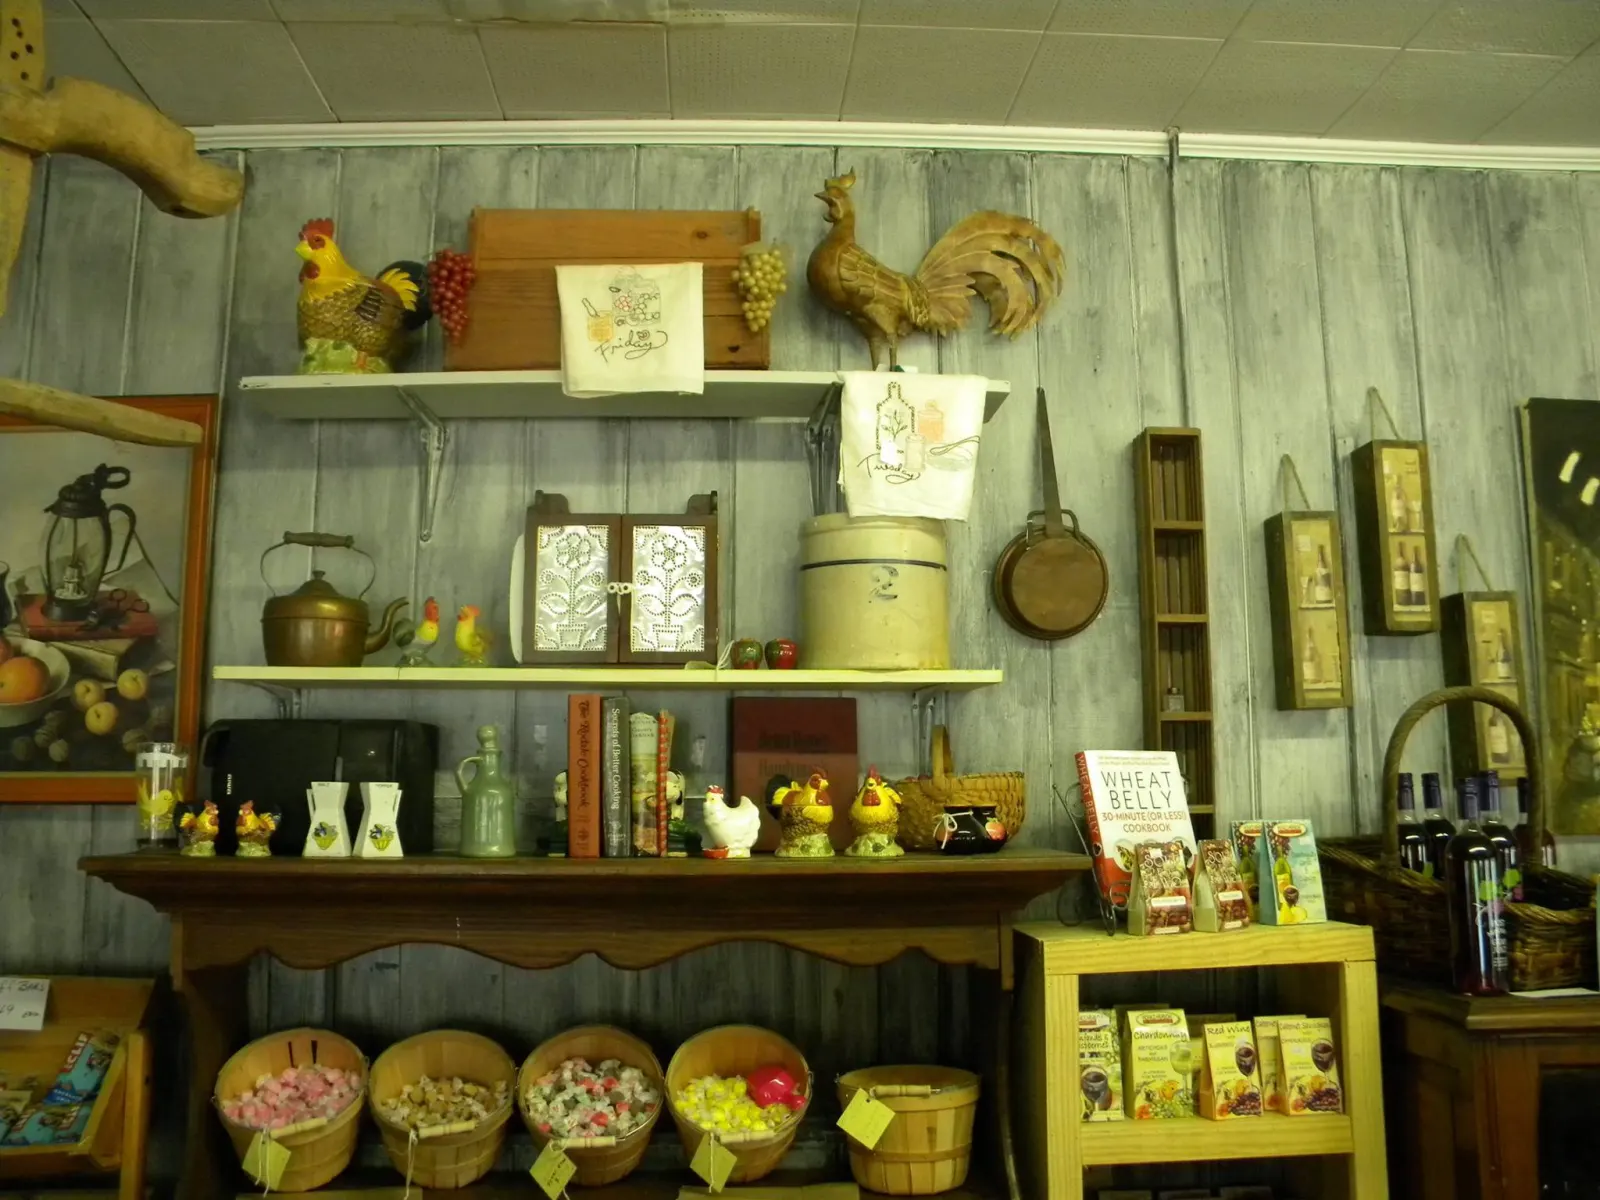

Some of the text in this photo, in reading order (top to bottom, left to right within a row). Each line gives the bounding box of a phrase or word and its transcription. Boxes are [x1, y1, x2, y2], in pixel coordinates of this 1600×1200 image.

[594, 329, 668, 363] Friday
[857, 453, 921, 484] Tuesday
[870, 565, 899, 601] 2
[578, 700, 590, 718] The
[610, 708, 621, 809] Secrets of Better Cooking
[577, 758, 591, 810] Cookbook
[1101, 771, 1171, 788] WHEAT
[1078, 755, 1099, 834] WHEAT BELLY
[1109, 790, 1171, 809] BELLY
[1102, 812, 1146, 821] 30-MINUTE
[1147, 812, 1162, 822] (OR
[1123, 823, 1172, 833] COOKBOOK
[1133, 1029, 1188, 1042] Chardonnay
[1207, 1023, 1250, 1034] Red Wine
